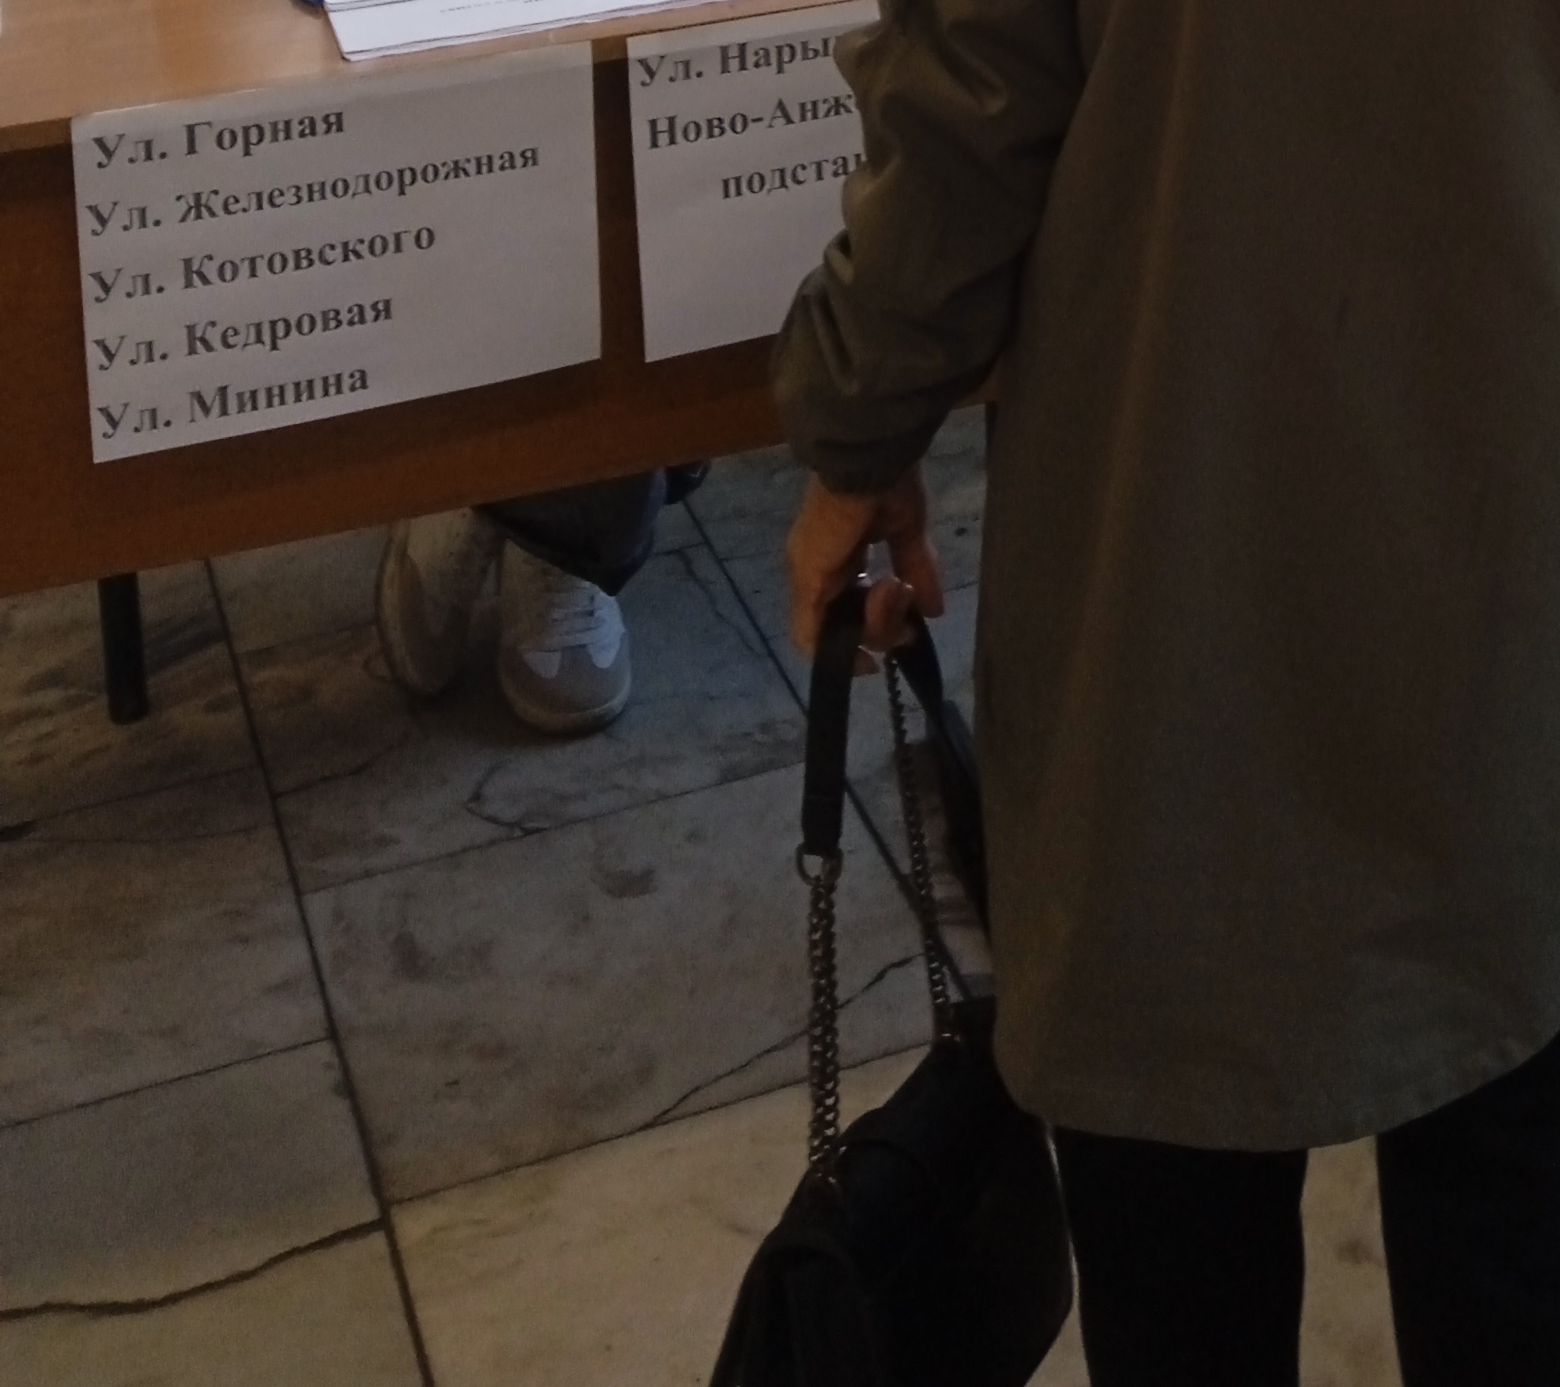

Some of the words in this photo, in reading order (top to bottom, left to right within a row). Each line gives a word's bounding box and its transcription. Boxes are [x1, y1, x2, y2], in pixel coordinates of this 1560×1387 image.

[637, 55, 704, 88] Ул.
[719, 36, 839, 76] Нары
[91, 132, 169, 171] Ул.
[184, 107, 346, 160] Горная
[85, 200, 162, 239] Ул.
[176, 142, 541, 227] Железнодорожная
[88, 268, 165, 306] Ул.
[180, 224, 436, 291] Котовского
[92, 336, 169, 374] Ул.
[184, 295, 394, 359] Кедровая
[96, 402, 174, 441] Ул.
[187, 365, 370, 425] Минина
